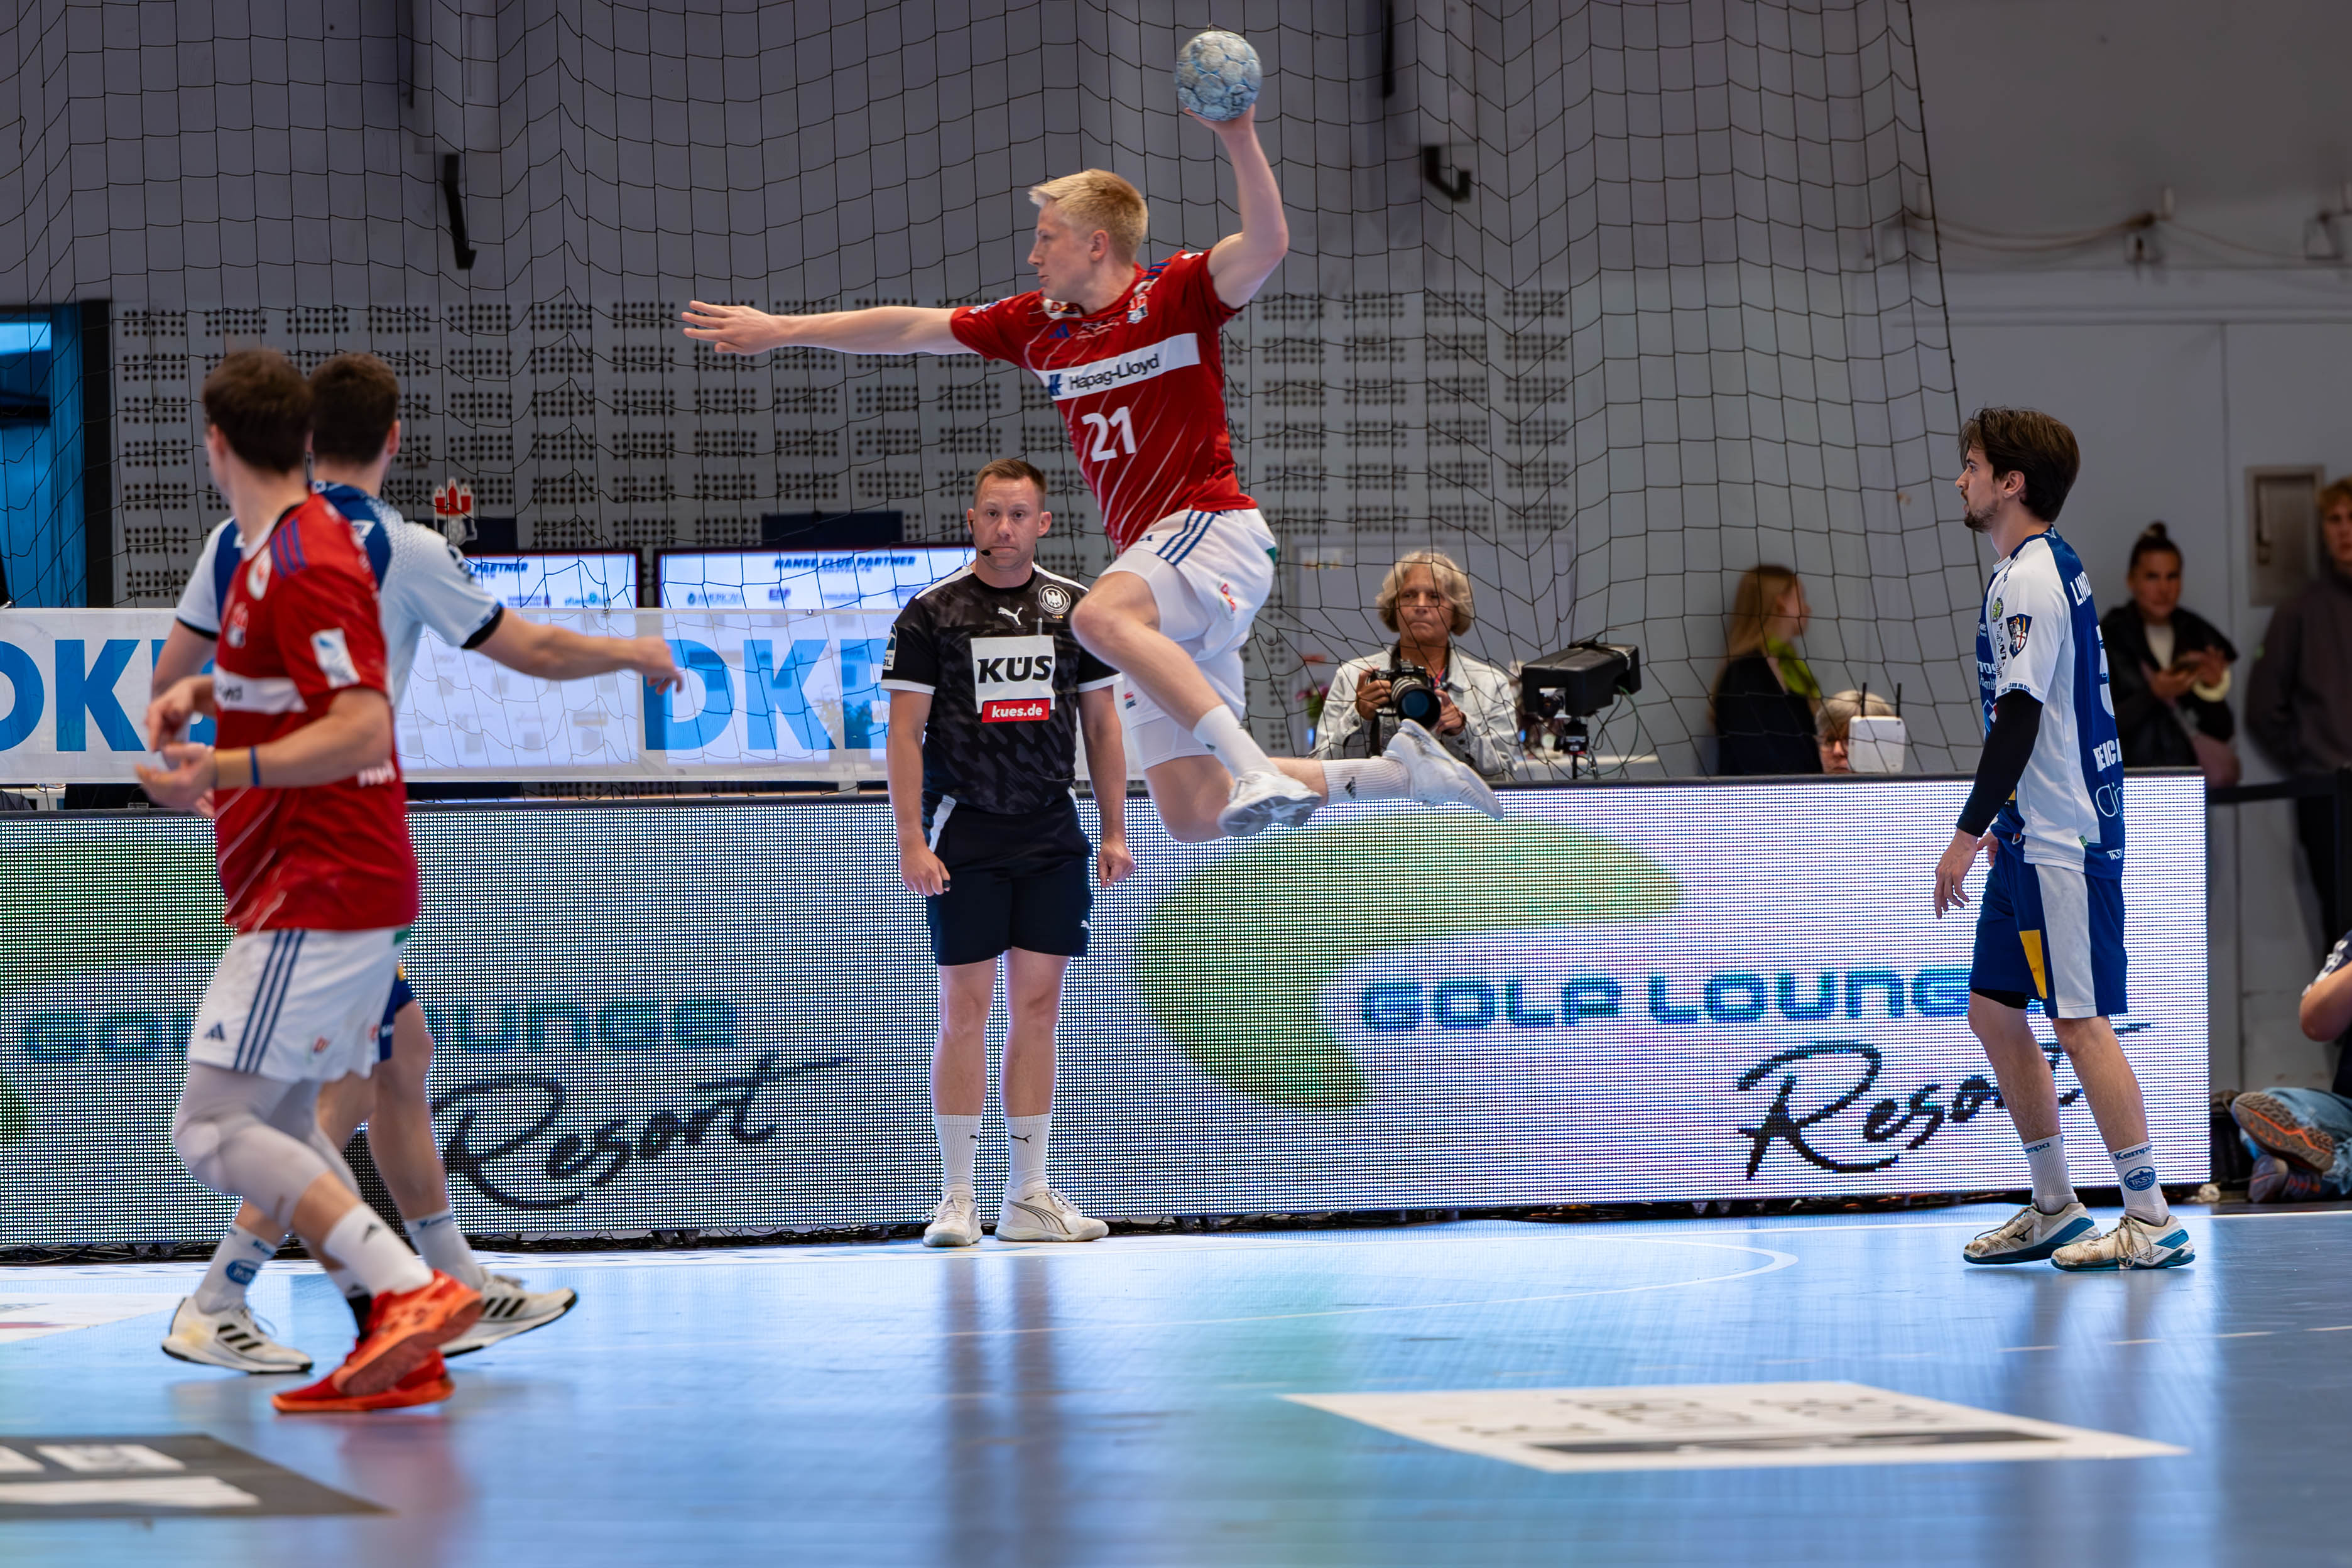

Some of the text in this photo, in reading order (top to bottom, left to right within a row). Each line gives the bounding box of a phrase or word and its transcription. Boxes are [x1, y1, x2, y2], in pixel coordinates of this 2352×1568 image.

[1069, 353, 1160, 390] Hapag-Lloyd
[1081, 406, 1136, 462] 21
[856, 556, 916, 568] PARTNER
[977, 655, 1052, 683] KÜS
[991, 704, 1043, 718] kues.de
[1648, 966, 2042, 1025] LOUNG
